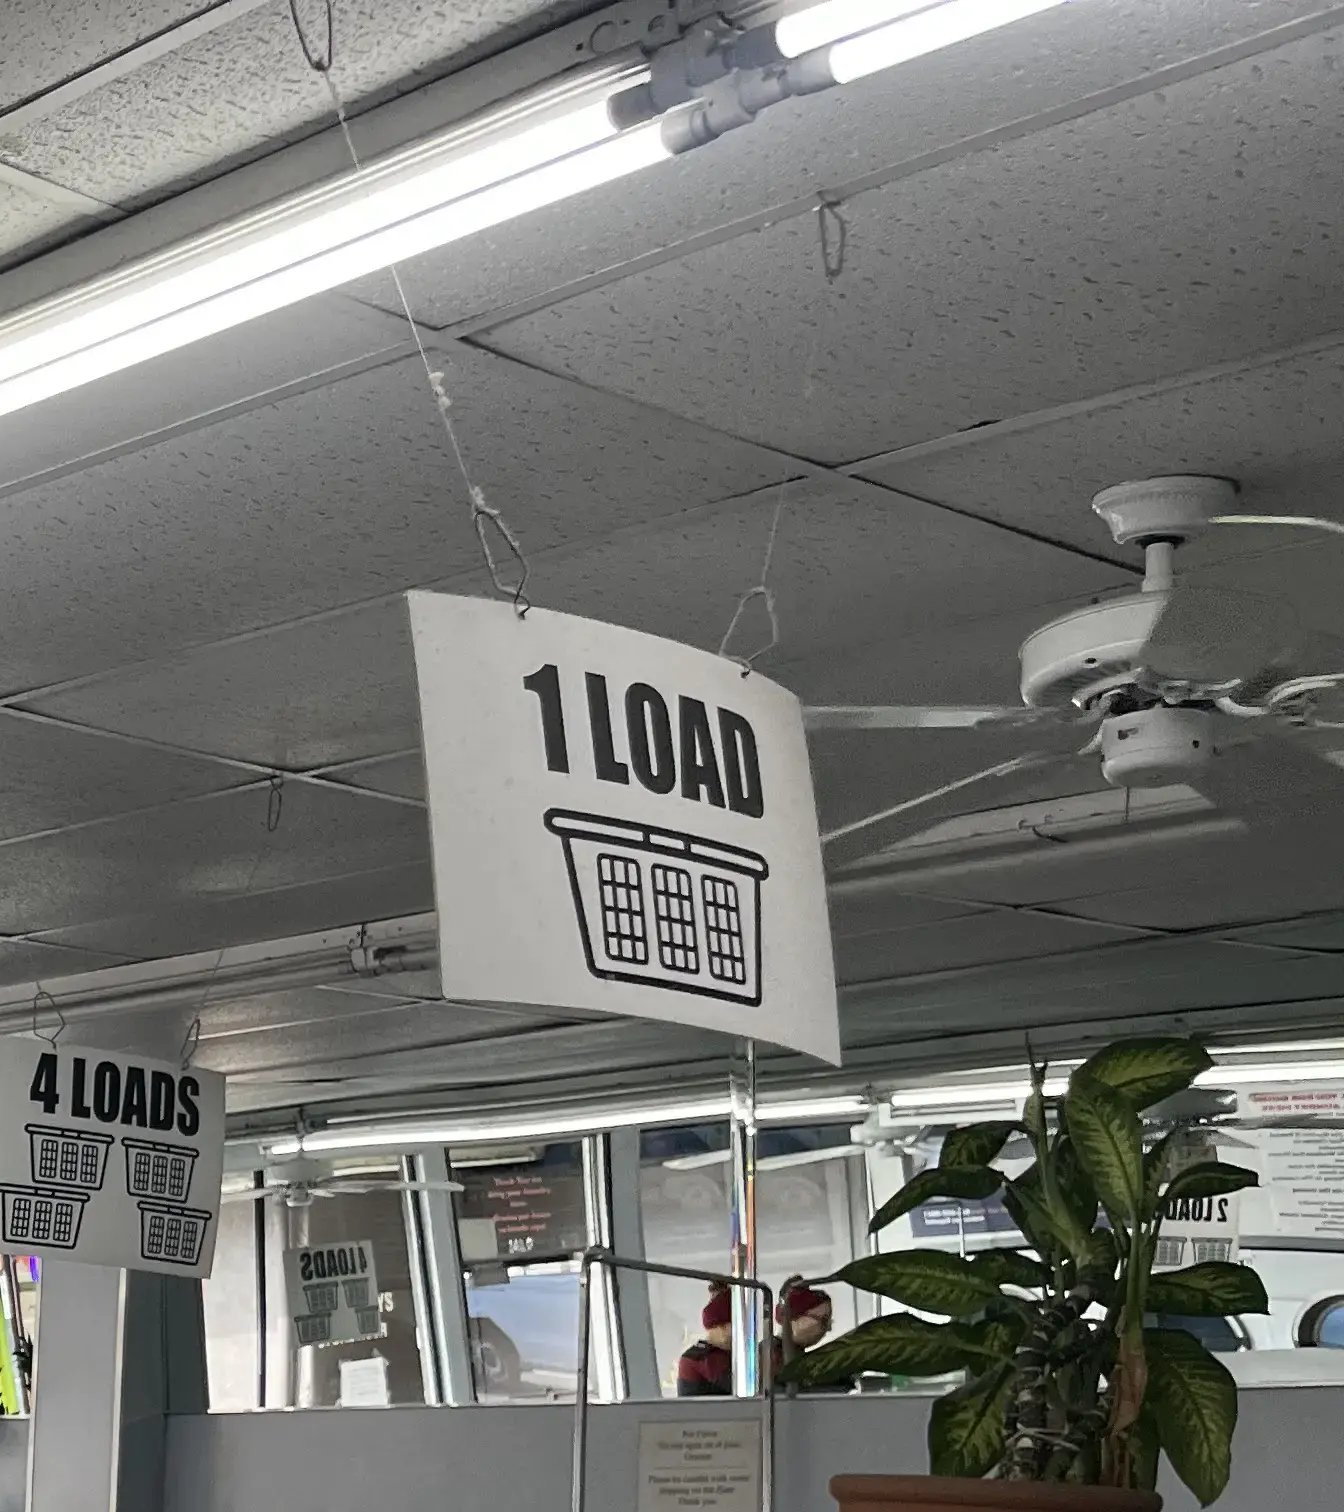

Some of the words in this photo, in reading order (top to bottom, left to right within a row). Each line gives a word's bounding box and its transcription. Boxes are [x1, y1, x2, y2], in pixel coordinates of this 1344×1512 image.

[523, 664, 570, 774] 1
[585, 671, 764, 819] LOAD
[30, 1053, 59, 1114] 4
[71, 1057, 200, 1136] LOADS
